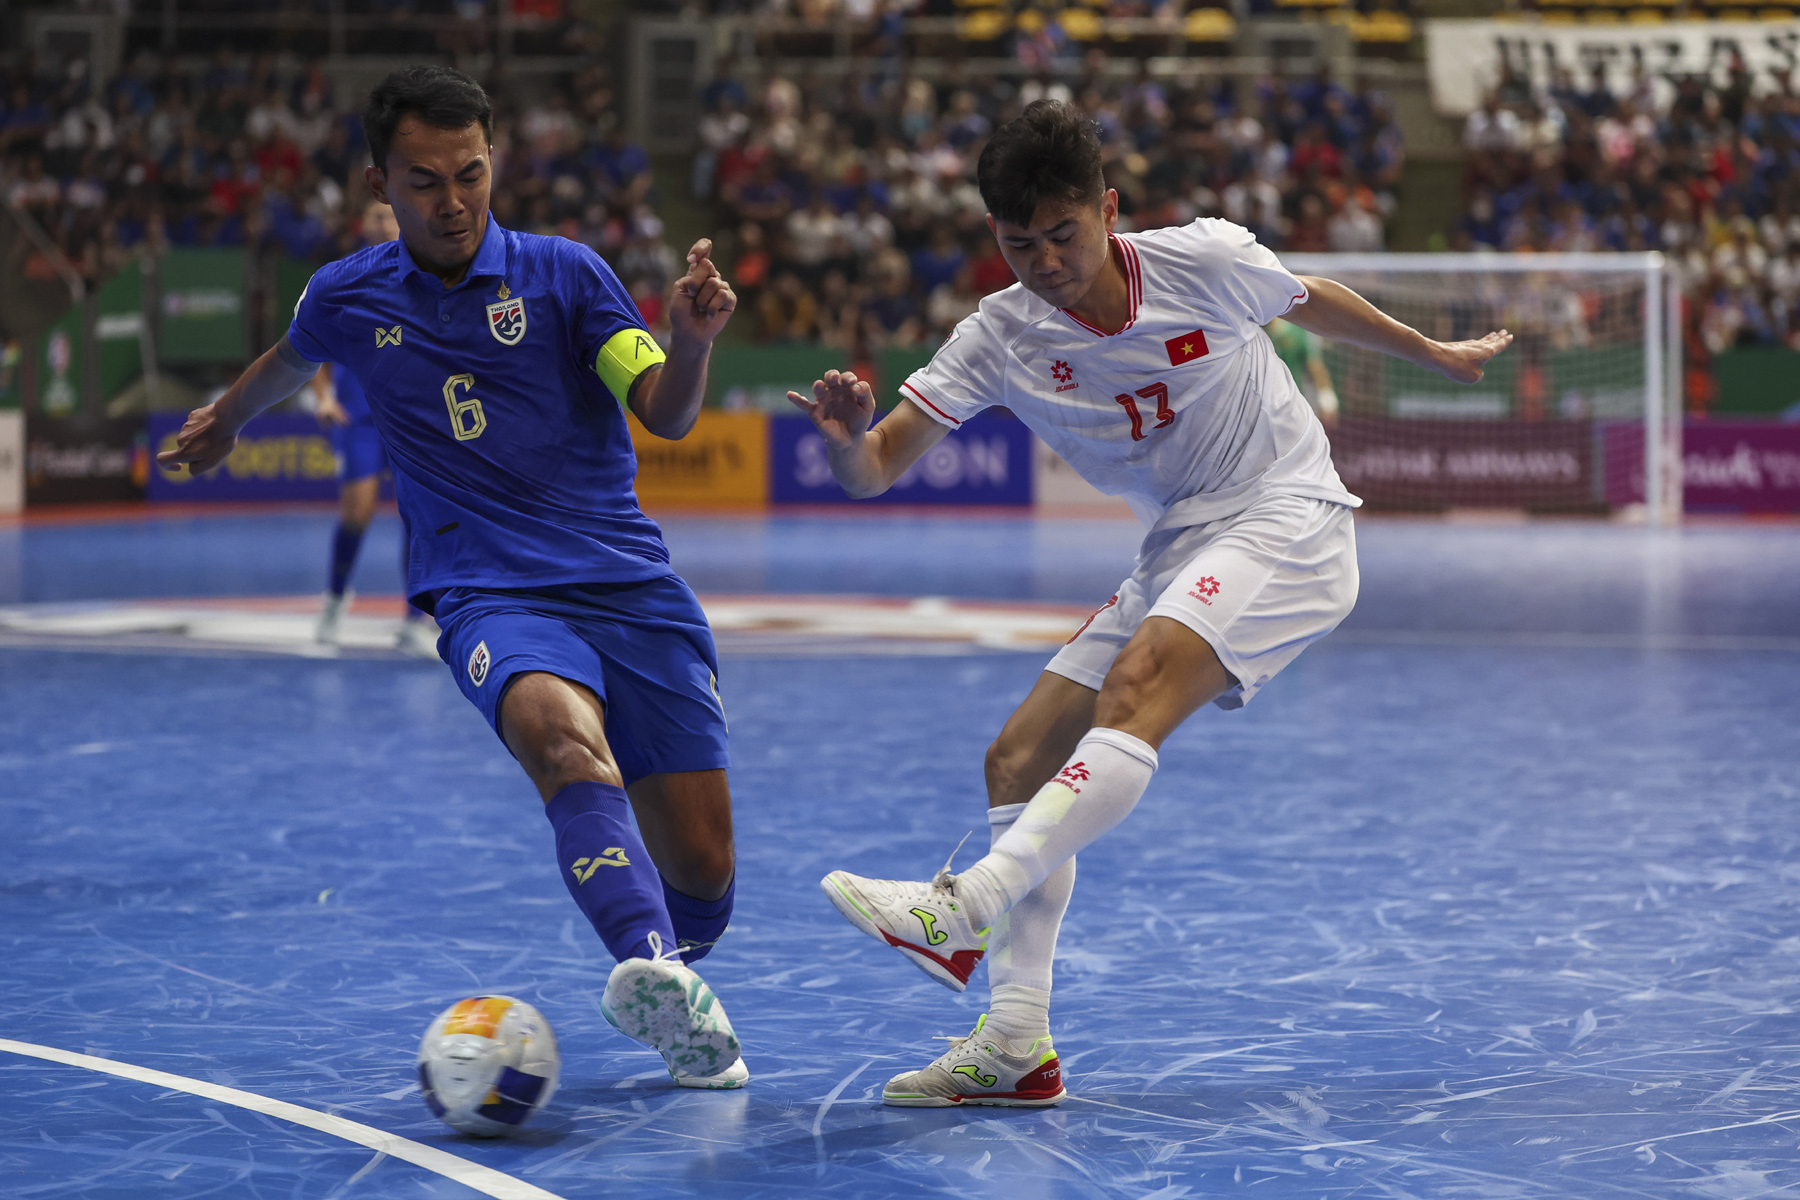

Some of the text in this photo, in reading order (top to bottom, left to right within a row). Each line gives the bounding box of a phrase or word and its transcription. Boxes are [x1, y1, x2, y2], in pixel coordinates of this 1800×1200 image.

[490, 302, 520, 313] THAILAND
[442, 373, 487, 441] 6
[1115, 381, 1176, 441] 13
